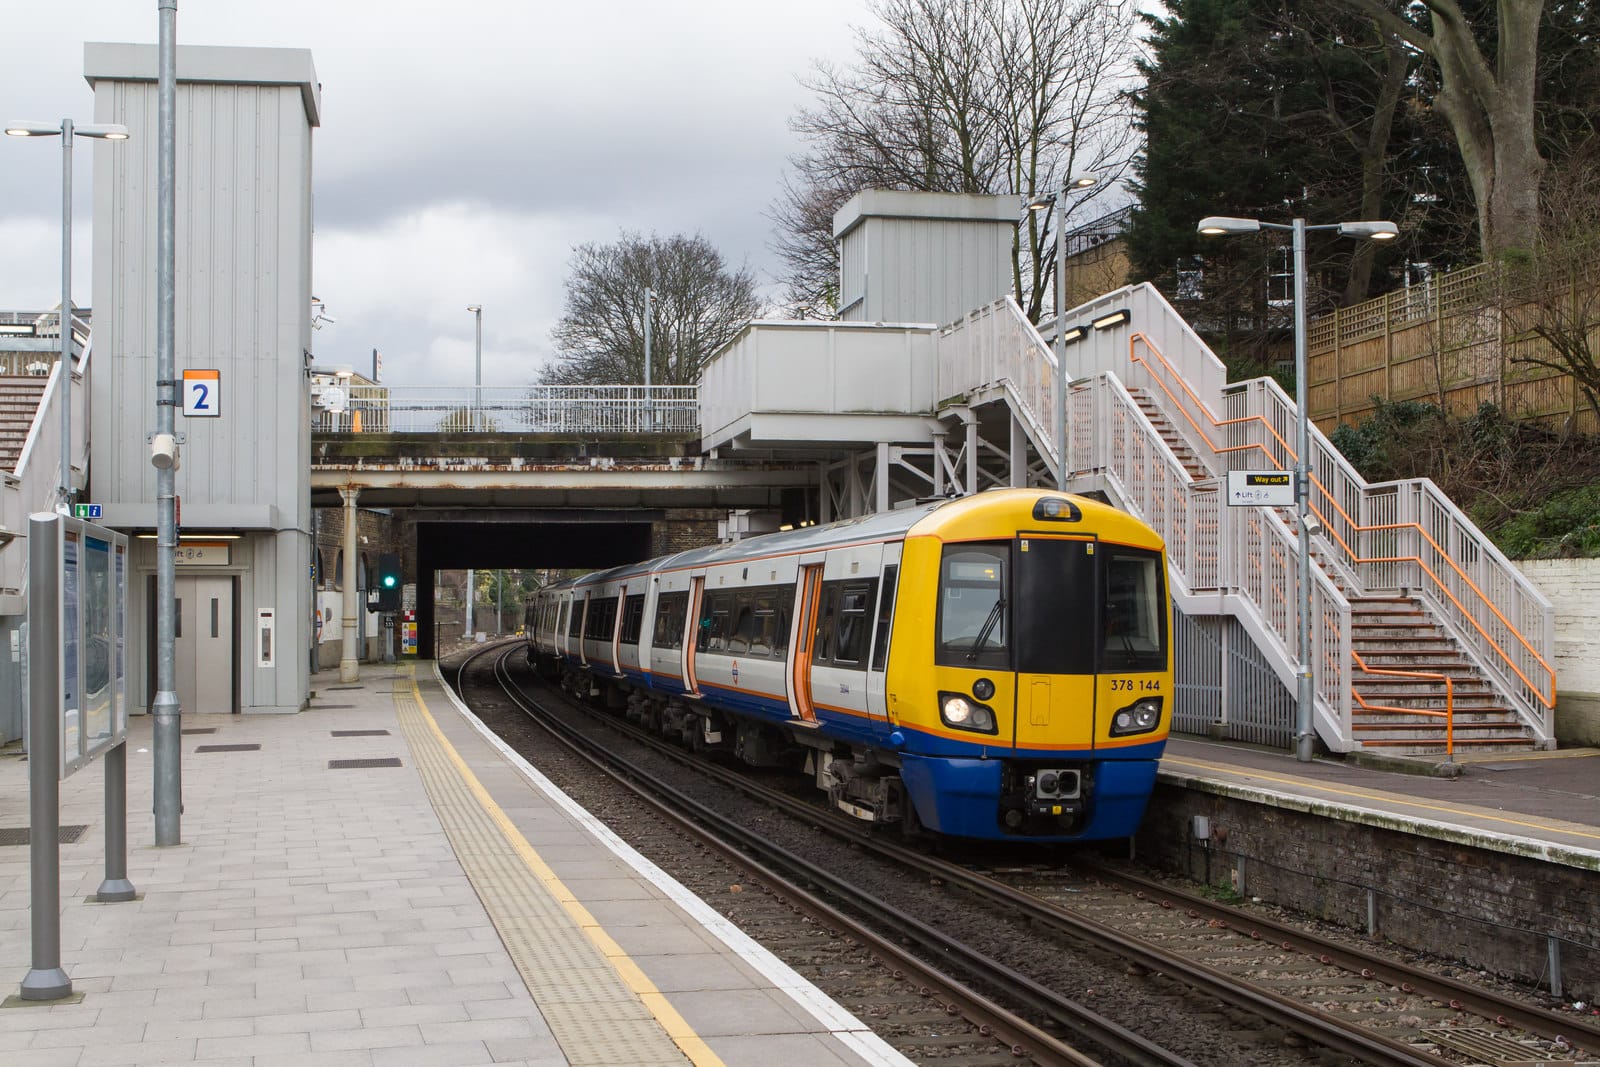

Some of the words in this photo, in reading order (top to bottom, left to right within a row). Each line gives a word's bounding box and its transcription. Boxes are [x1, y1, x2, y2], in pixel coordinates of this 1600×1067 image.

[192, 383, 209, 410] 2
[1255, 476, 1269, 484] Way
[1111, 679, 1133, 691] 378
[1139, 679, 1161, 691] 144
